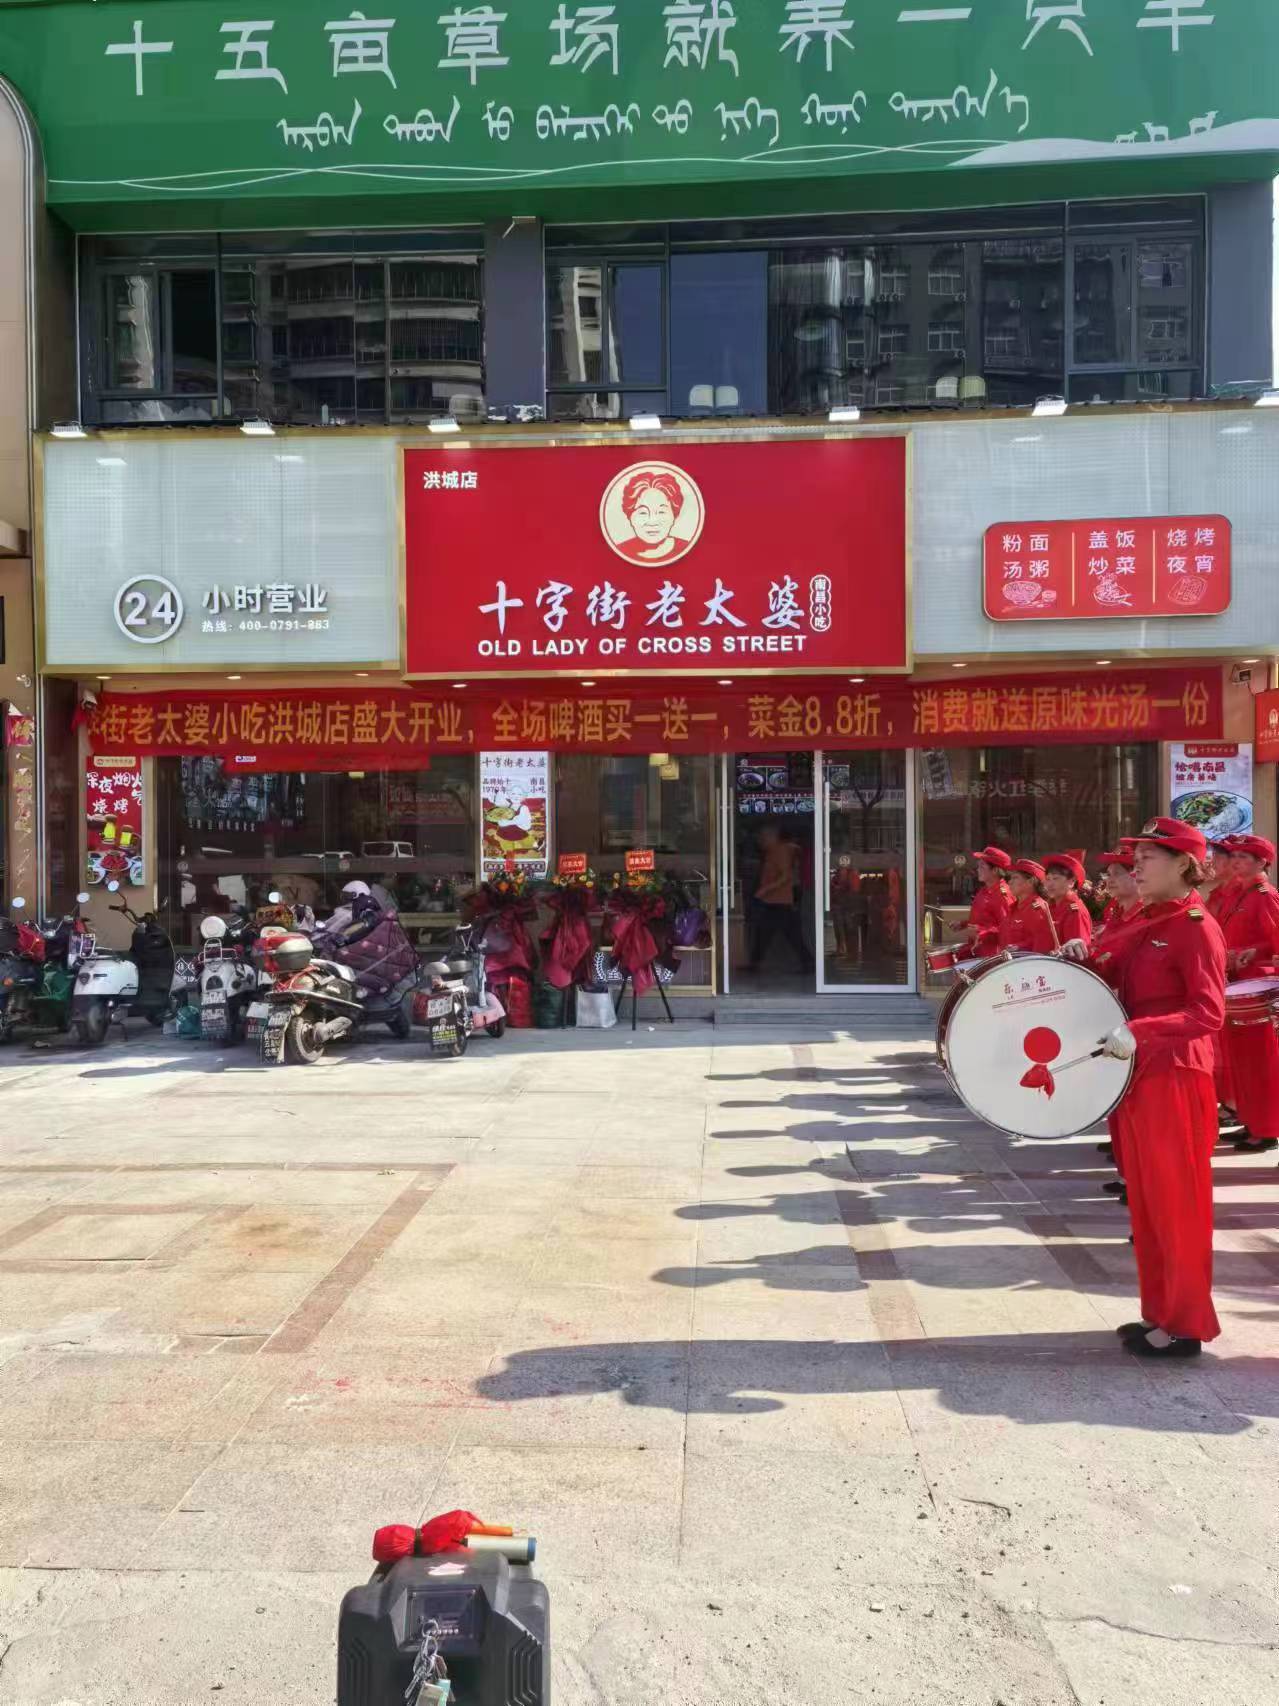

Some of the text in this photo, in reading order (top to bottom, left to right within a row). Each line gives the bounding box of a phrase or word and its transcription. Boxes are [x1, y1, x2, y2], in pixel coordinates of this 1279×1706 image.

[423, 471, 478, 489] 洪城店
[1002, 533, 1049, 553] 粉面
[1088, 530, 1136, 549] 盖饭
[1166, 528, 1216, 547] 烧烤
[1003, 559, 1049, 579] 汤粥
[1088, 556, 1136, 576] 炒菜
[1166, 555, 1215, 574] 夜宵
[124, 582, 328, 626] 24 小时营业
[477, 575, 806, 635] 十字街老太婆
[814, 578, 827, 628] 南昌小吃
[478, 635, 808, 656] OLD LADY OF CROSS STREET
